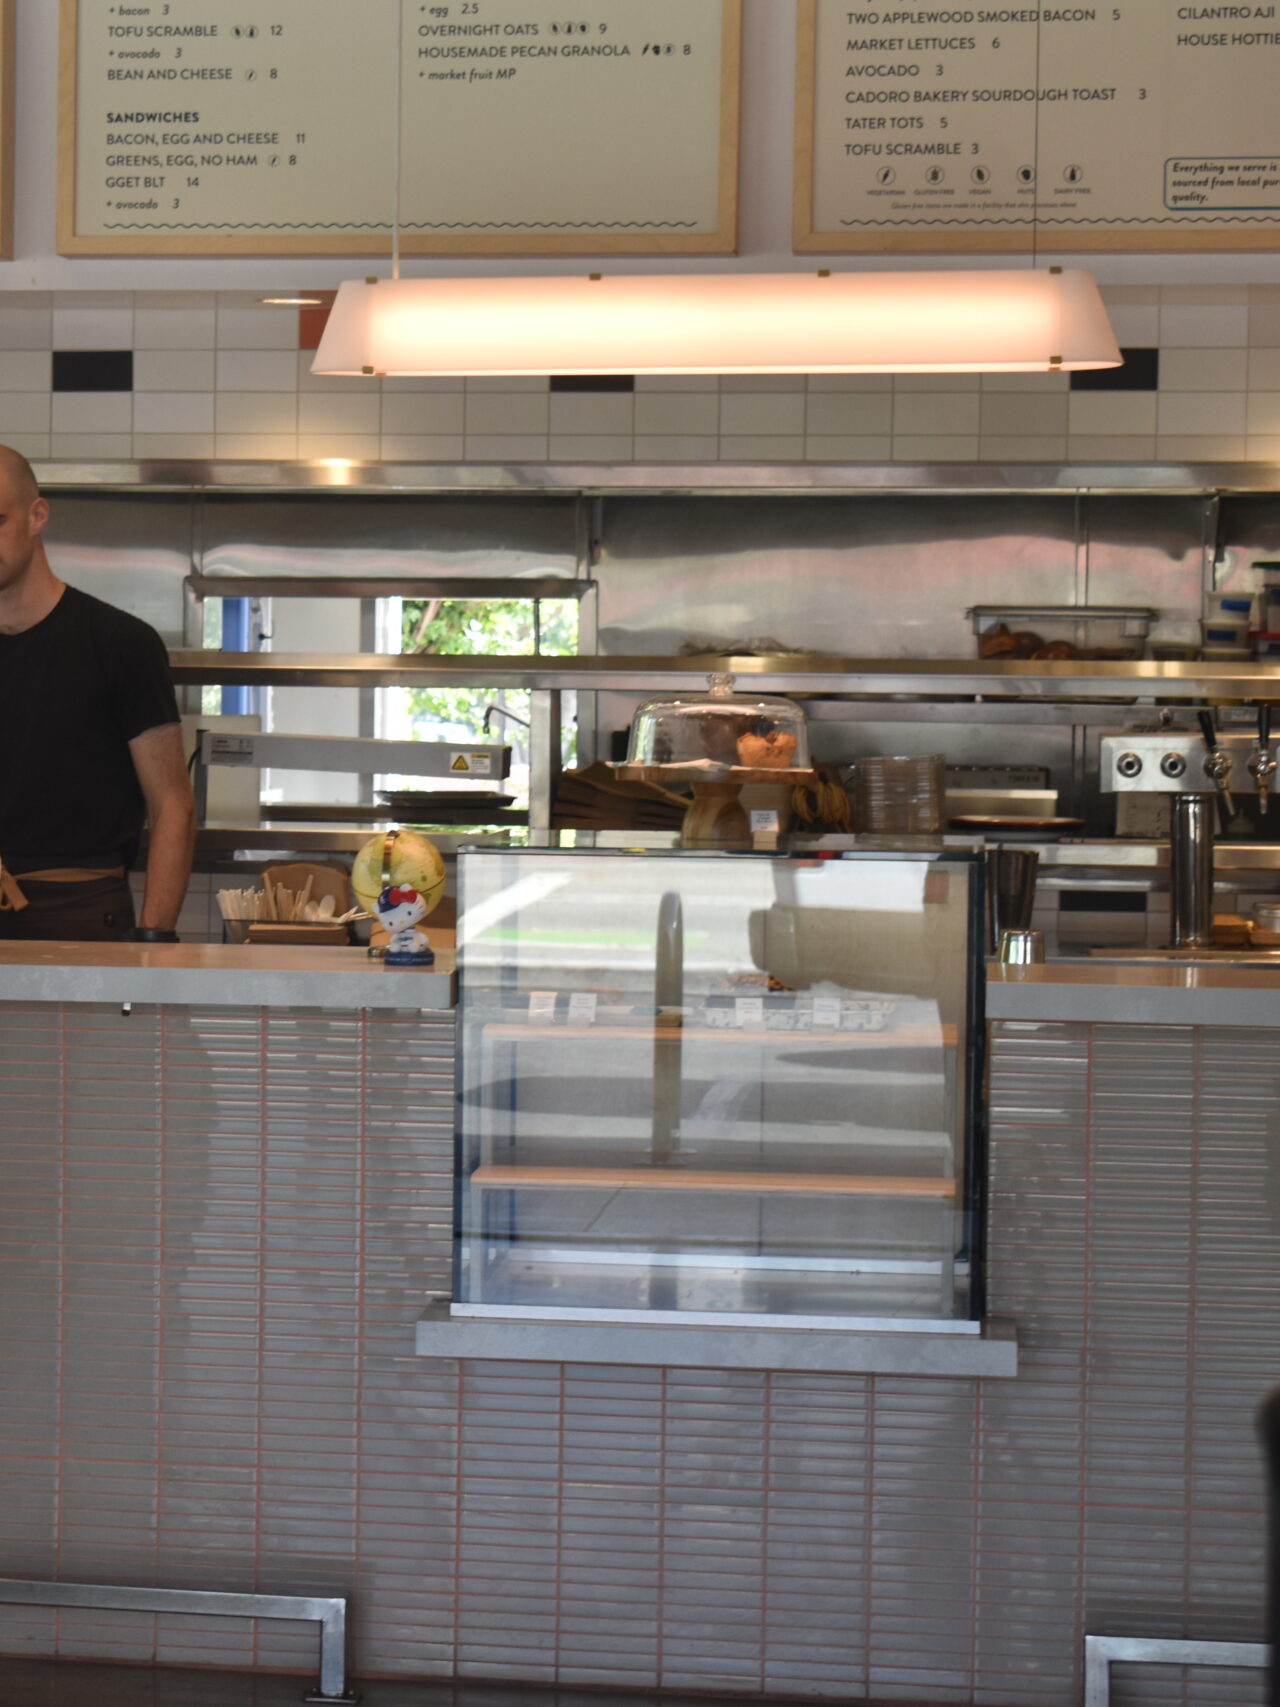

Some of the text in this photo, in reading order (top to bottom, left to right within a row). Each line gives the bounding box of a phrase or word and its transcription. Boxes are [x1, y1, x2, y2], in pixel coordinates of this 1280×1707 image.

[118, 4, 170, 16] bacon 3
[429, 3, 479, 18] egg 2.5
[1177, 6, 1275, 19] CILANTRO AJI
[848, 9, 1120, 24] TWO APPLEWOOD SMOKED BACON 5
[108, 25, 282, 37] TOFU SCRAMBLE 12
[418, 23, 607, 36] OVERNIGHT OATS 9
[846, 37, 1000, 51] MARKET LETTUCES 6
[1177, 34, 1228, 46] HOUSE
[118, 47, 182, 59] avocado 3
[418, 44, 691, 58] HOUSEMADE PECAN GRANOLA 8
[108, 68, 277, 80] BEAN AND CHEESE 8
[428, 68, 516, 83] market fruit MP
[846, 64, 943, 77] AVOCADO 3
[845, 88, 1146, 103] CADORO BAKERY SOURDOUGH TOAST 3
[107, 112, 199, 123] SANDWICHES
[845, 117, 948, 129] TATER TOTS 5
[106, 133, 305, 146] BACON, EGG AND CHEESE 11
[844, 143, 979, 156] TOFU SCRAMBLE 3
[106, 155, 296, 167] GREENS, EGG, NO HAM 8
[1172, 163, 1225, 175] Everything
[105, 176, 199, 188] GGET BLT 14
[1237, 177, 1261, 186] local
[116, 198, 180, 209] avocado 3
[1172, 192, 1208, 204] quality.
